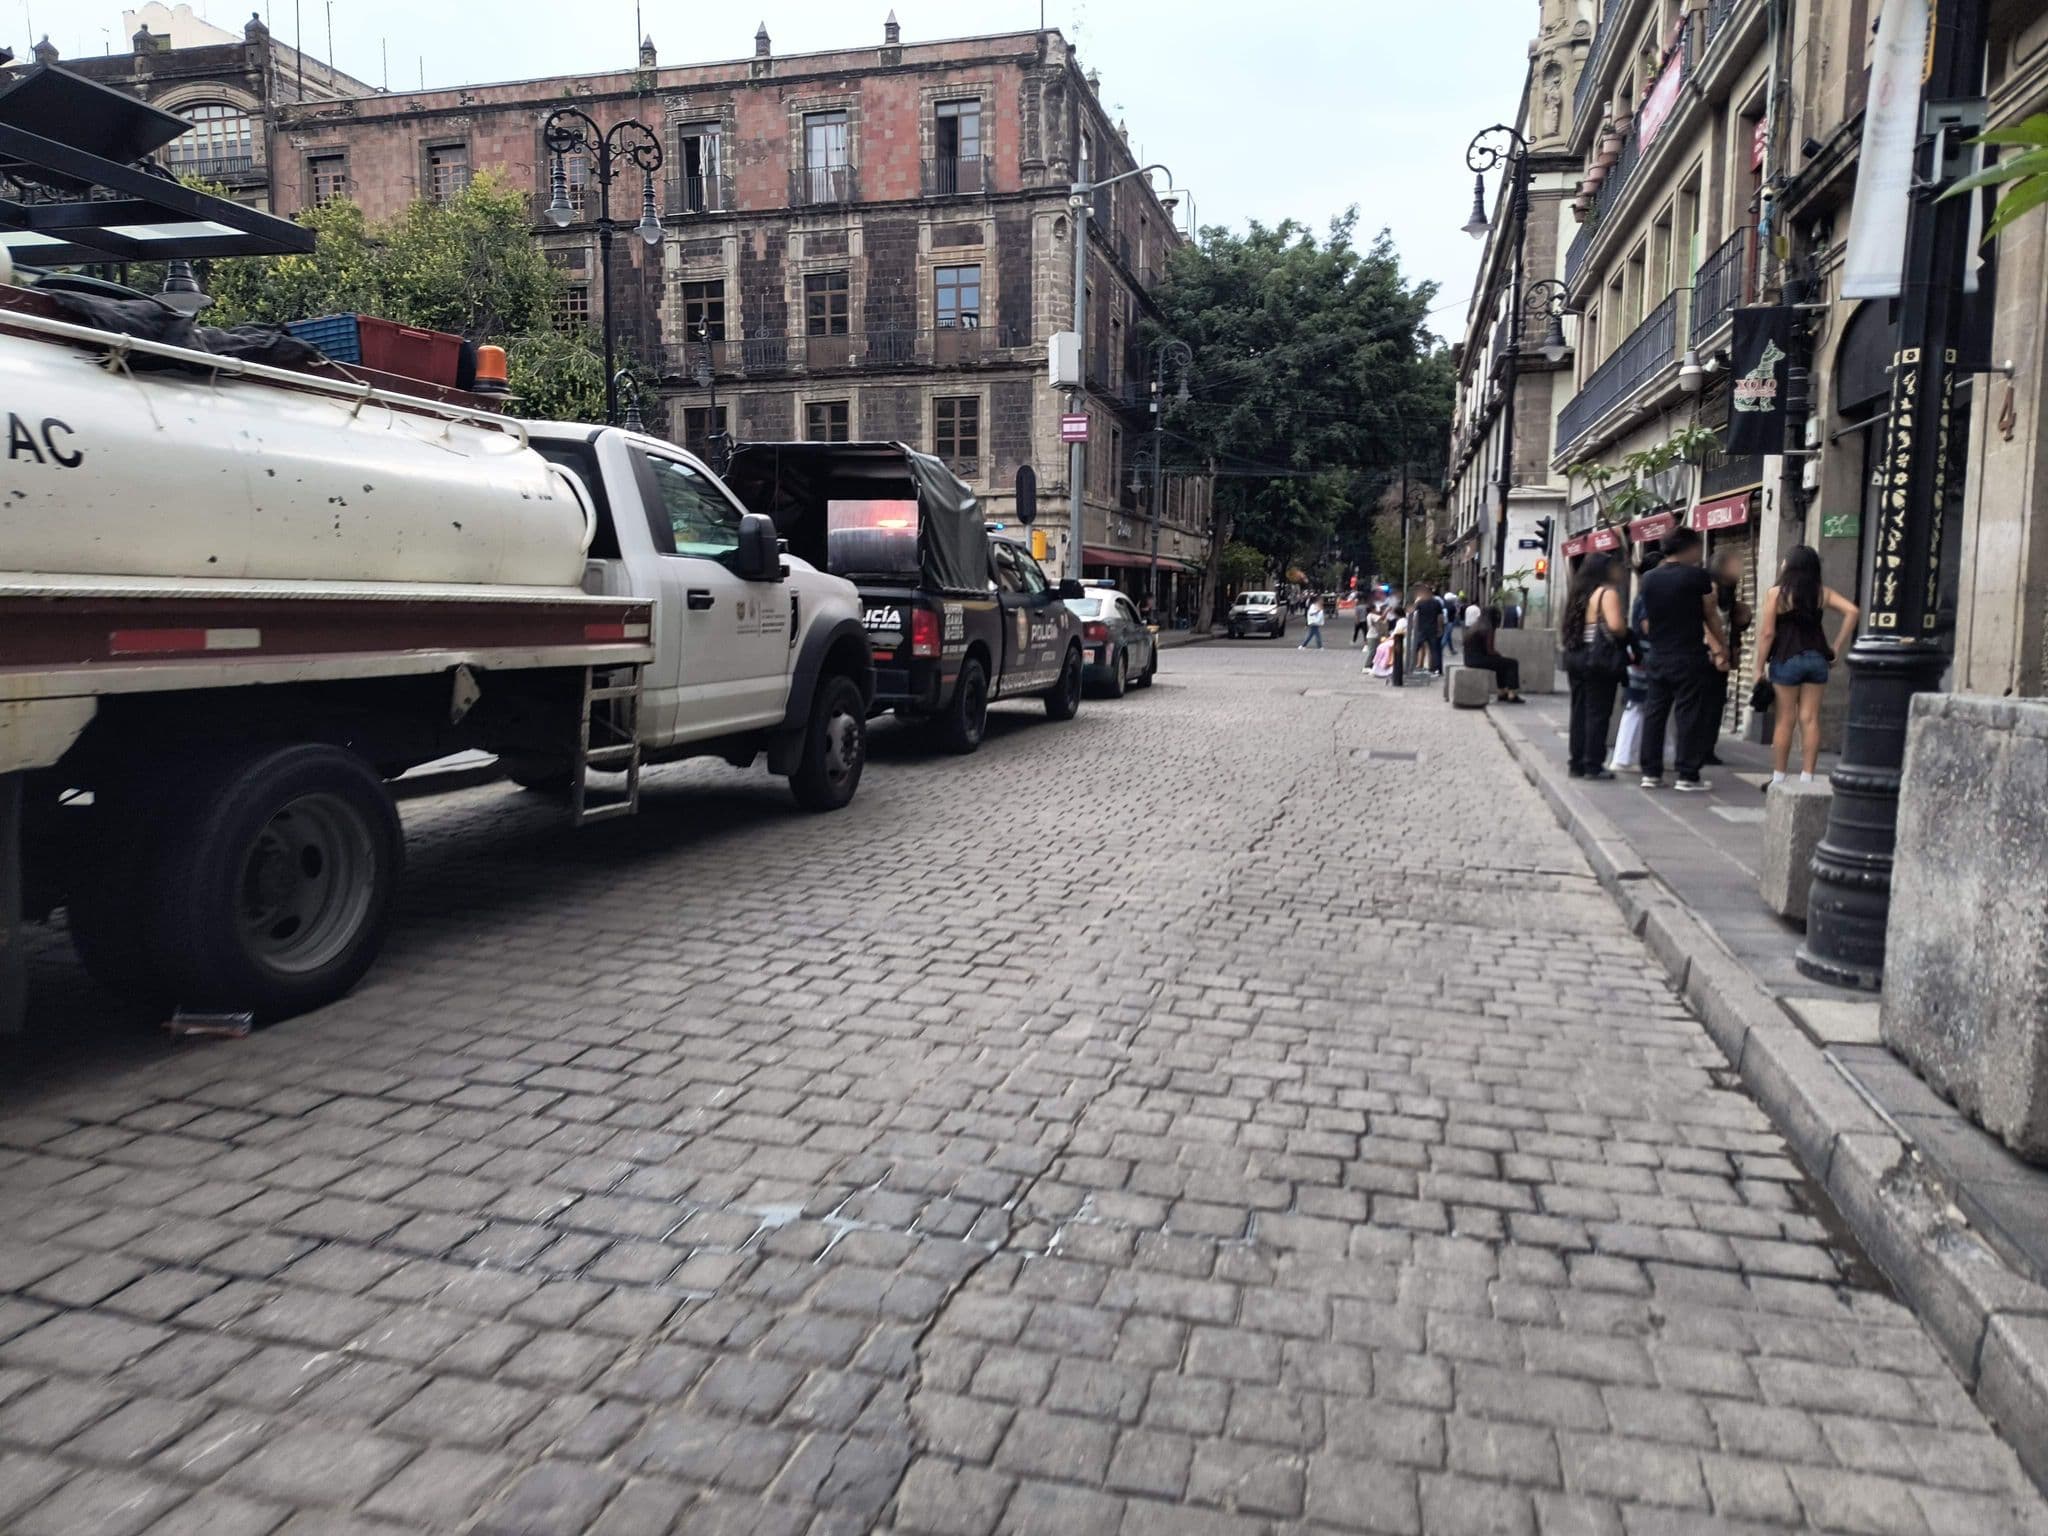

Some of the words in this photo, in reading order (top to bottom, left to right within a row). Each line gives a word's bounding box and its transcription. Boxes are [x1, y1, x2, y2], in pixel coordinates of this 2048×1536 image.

[1734, 379, 1777, 391] XOLO
[8, 412, 84, 468] AC
[1998, 387, 2017, 442] 4
